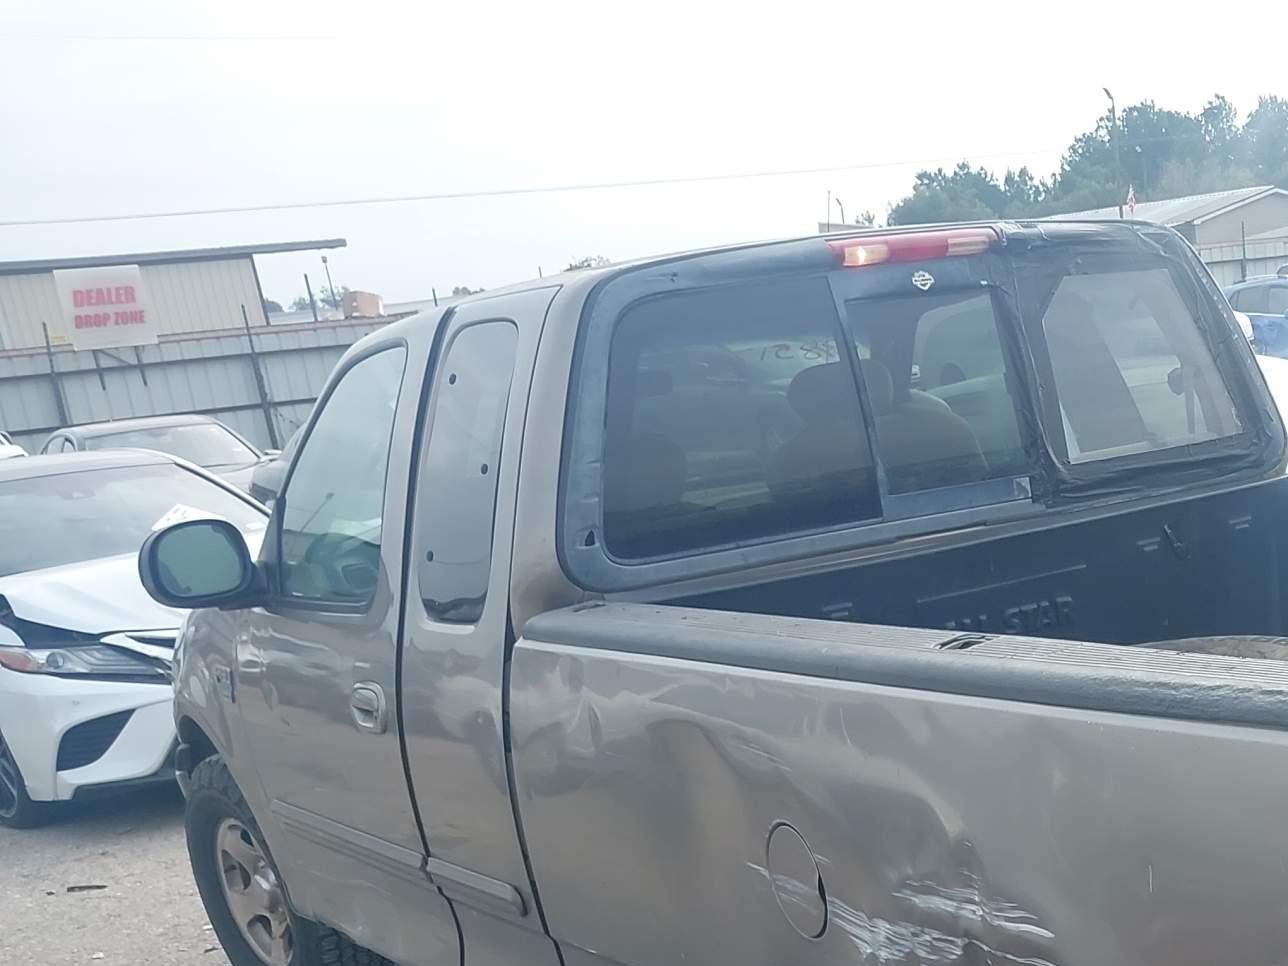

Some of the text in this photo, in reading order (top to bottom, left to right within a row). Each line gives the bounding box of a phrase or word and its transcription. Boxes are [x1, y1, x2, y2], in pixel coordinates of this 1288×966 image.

[72, 286, 136, 308] DEALER
[74, 310, 145, 329] DROP ZONE
